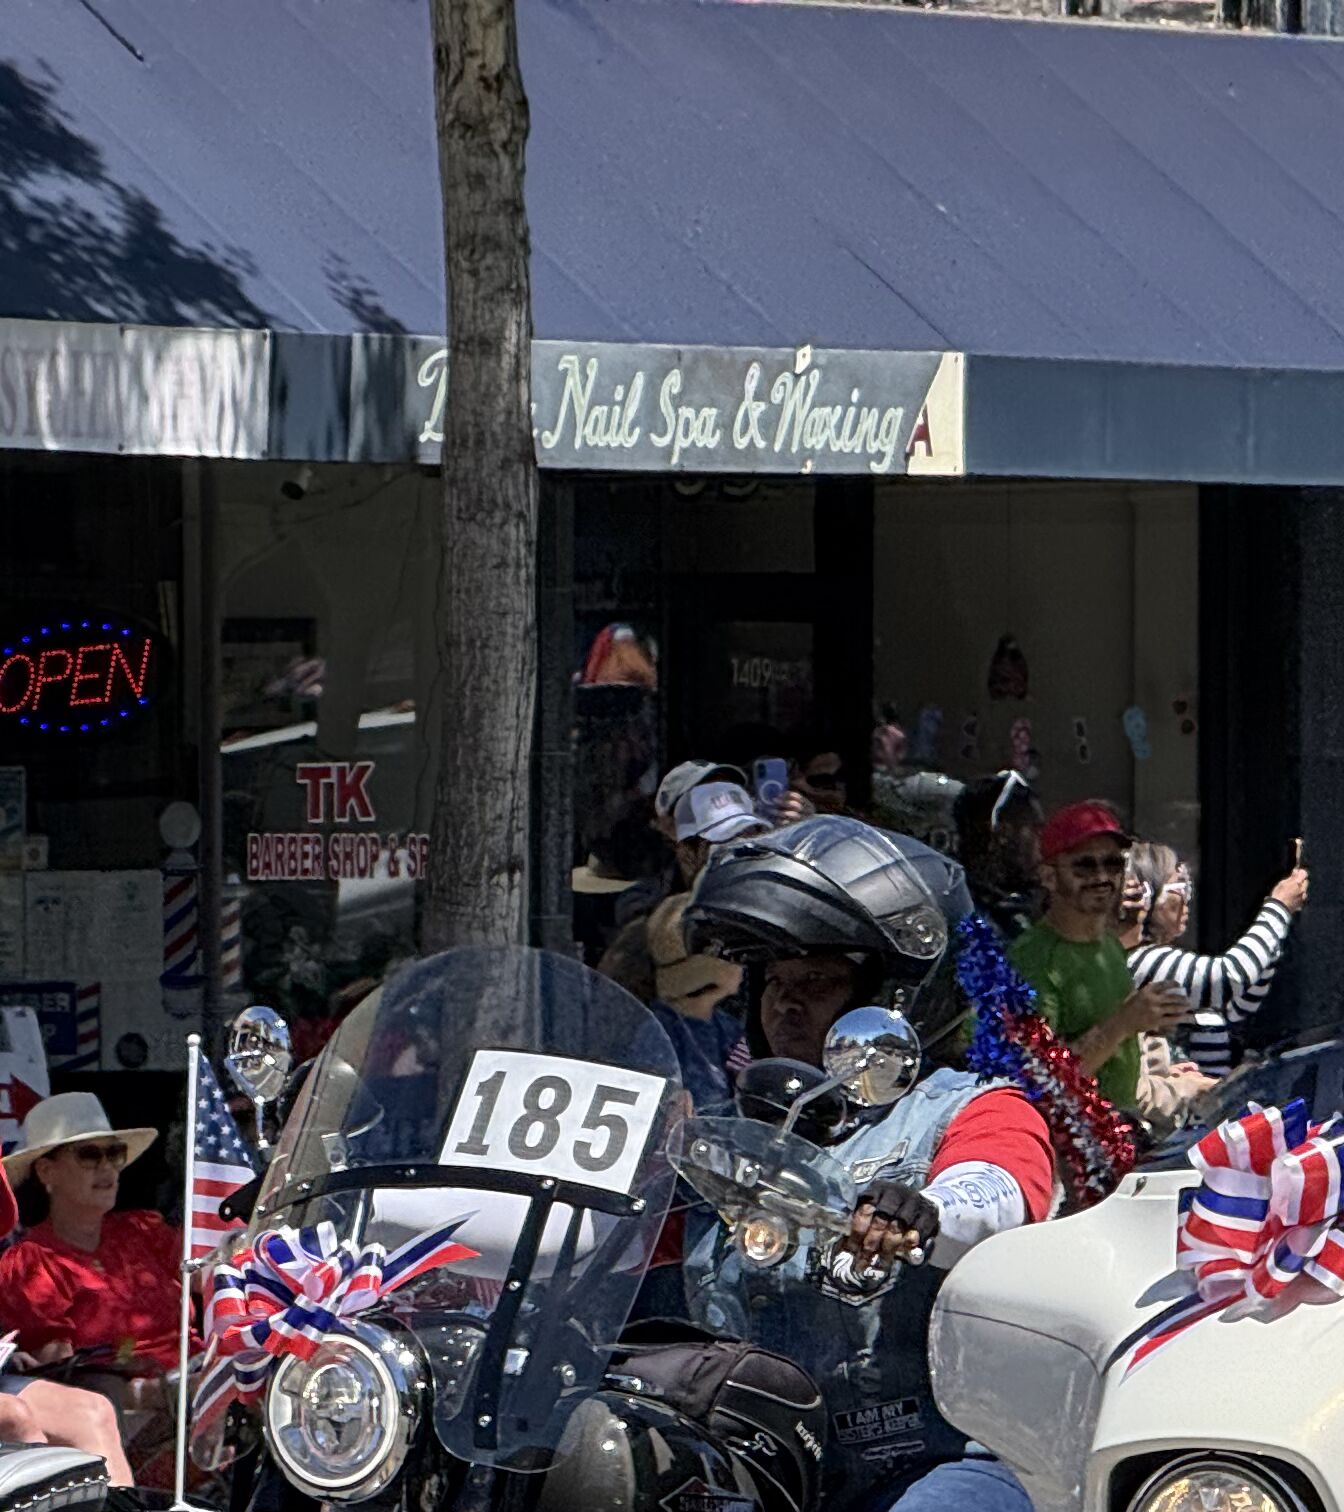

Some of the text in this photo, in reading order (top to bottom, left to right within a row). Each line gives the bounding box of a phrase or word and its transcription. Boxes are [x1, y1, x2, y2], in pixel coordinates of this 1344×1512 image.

[542, 355, 645, 450] Nail
[650, 368, 720, 464] Spa
[733, 362, 767, 450] &
[296, 761, 376, 823] TK
[247, 833, 325, 881] BARBER
[328, 833, 381, 880] SHOP
[455, 1070, 641, 1172] 185
